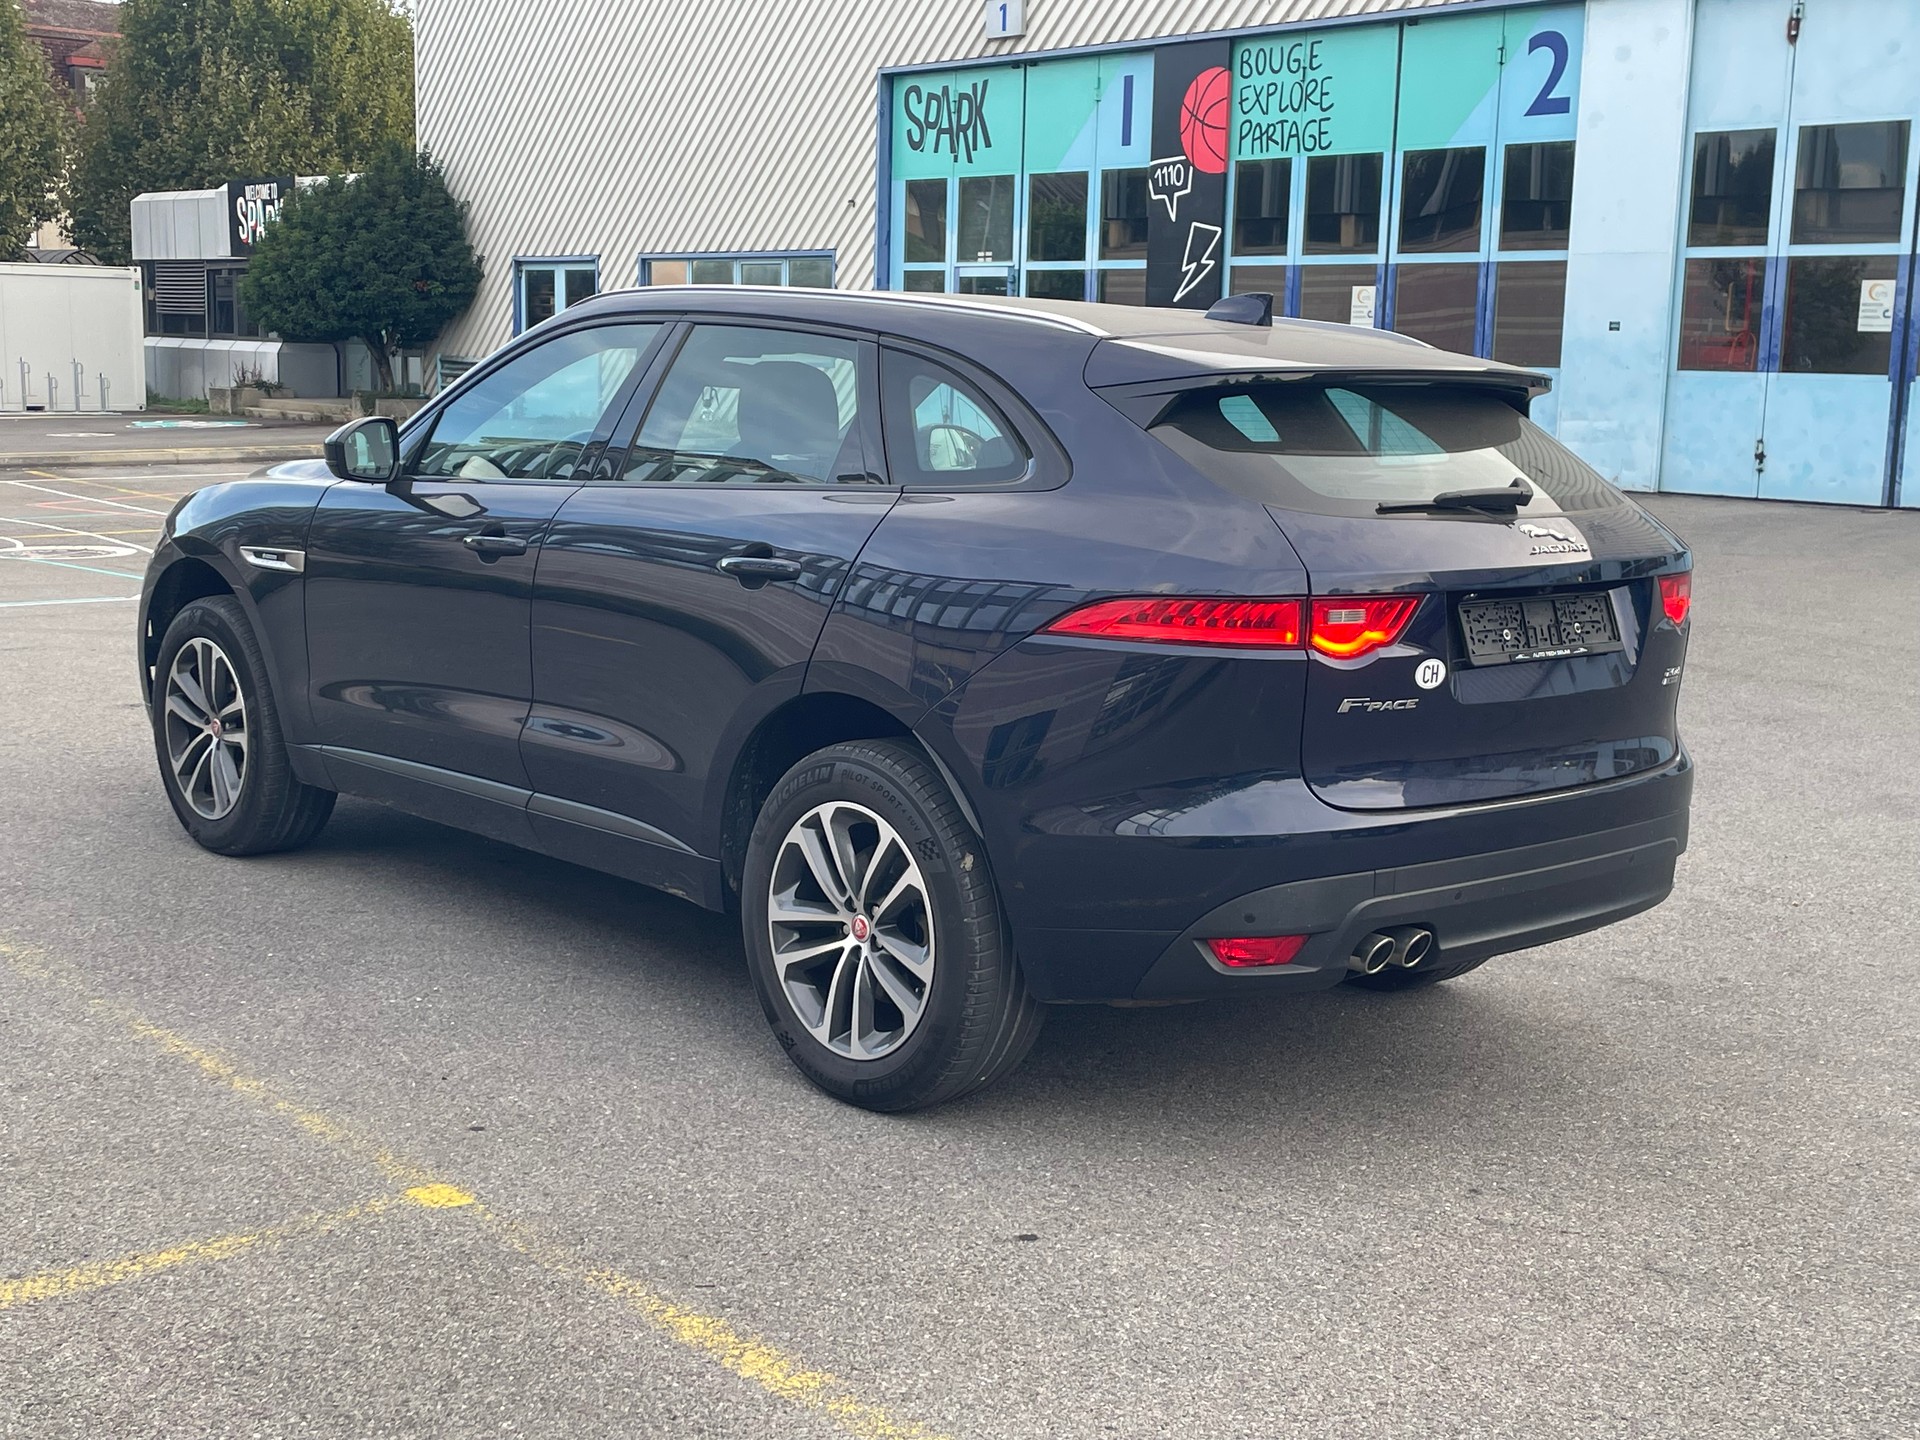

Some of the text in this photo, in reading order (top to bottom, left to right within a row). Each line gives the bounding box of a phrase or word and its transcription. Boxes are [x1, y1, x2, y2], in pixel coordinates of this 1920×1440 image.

[1000, 3, 1007, 31] 1
[1240, 40, 1323, 79] BOUGE
[1523, 30, 1571, 117] 2
[1238, 76, 1335, 115] EXPLORE
[904, 79, 992, 164] SPARK
[1238, 117, 1333, 155] PARTAGE
[1154, 163, 1185, 187] 1110
[1530, 543, 1588, 555] JAGUAR
[1422, 664, 1440, 684] CH
[841, 769, 868, 785] PILOT
[870, 781, 903, 811] SPORT
